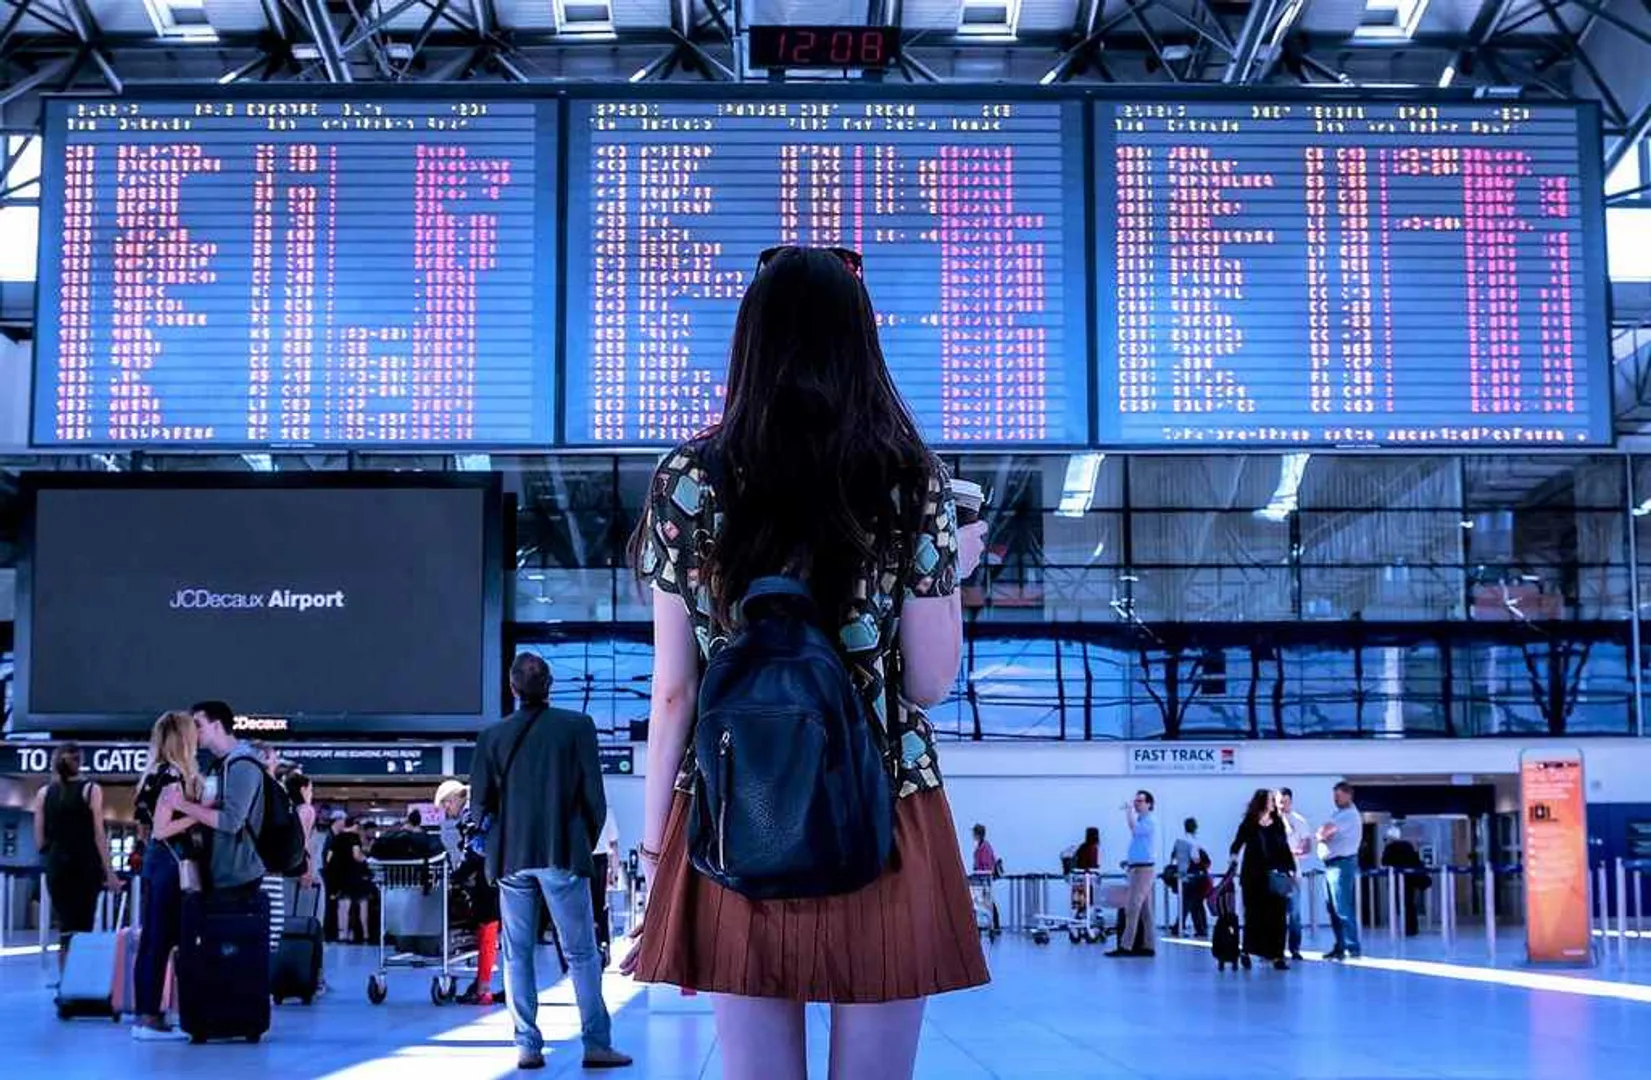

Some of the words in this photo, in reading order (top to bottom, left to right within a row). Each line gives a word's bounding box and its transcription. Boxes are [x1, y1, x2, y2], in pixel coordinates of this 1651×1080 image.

[169, 589, 264, 608] JCDecaux
[268, 589, 345, 612] Airport
[17, 748, 48, 772] TO
[1134, 749, 1166, 761] FAST
[1170, 749, 1215, 761] TRACK
